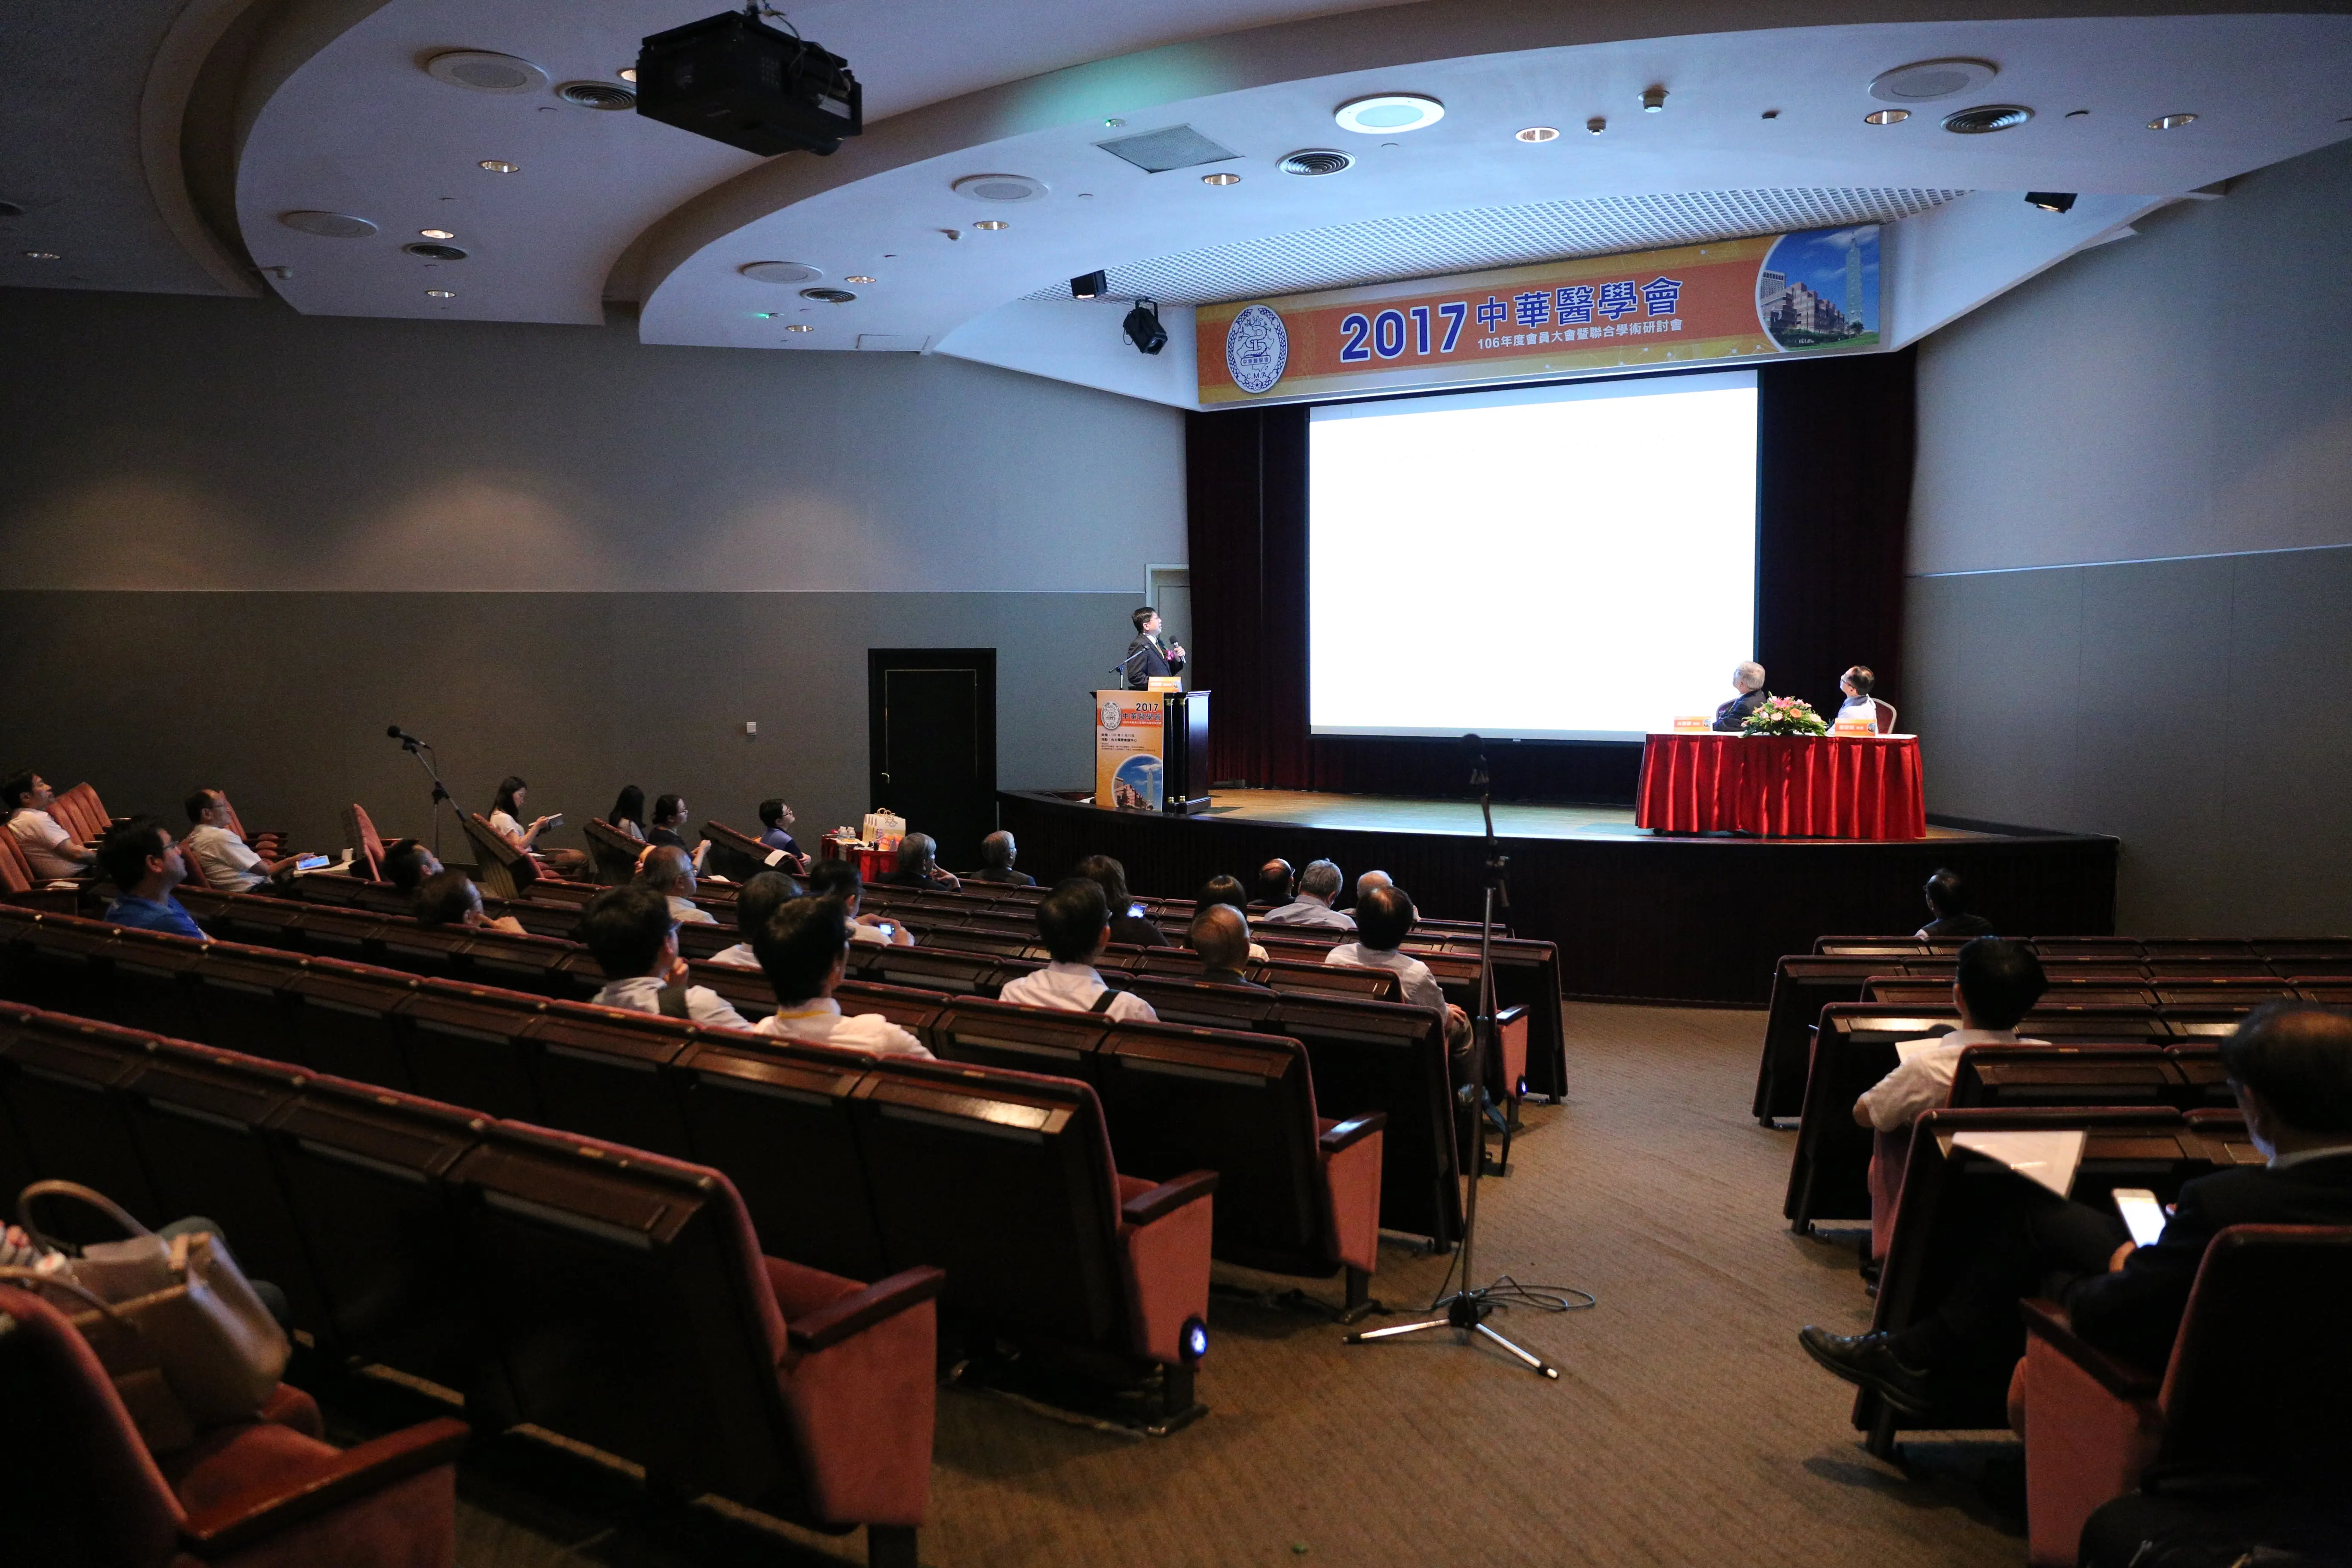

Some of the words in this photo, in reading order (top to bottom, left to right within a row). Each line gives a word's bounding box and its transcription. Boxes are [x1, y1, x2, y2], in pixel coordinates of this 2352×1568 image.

[1340, 301, 1467, 363] 2017
[1476, 276, 1683, 333] 中華醫學會
[1478, 318, 1683, 349] 106年度會員大會暨聯合學術研討會
[1136, 702, 1159, 712] 2017
